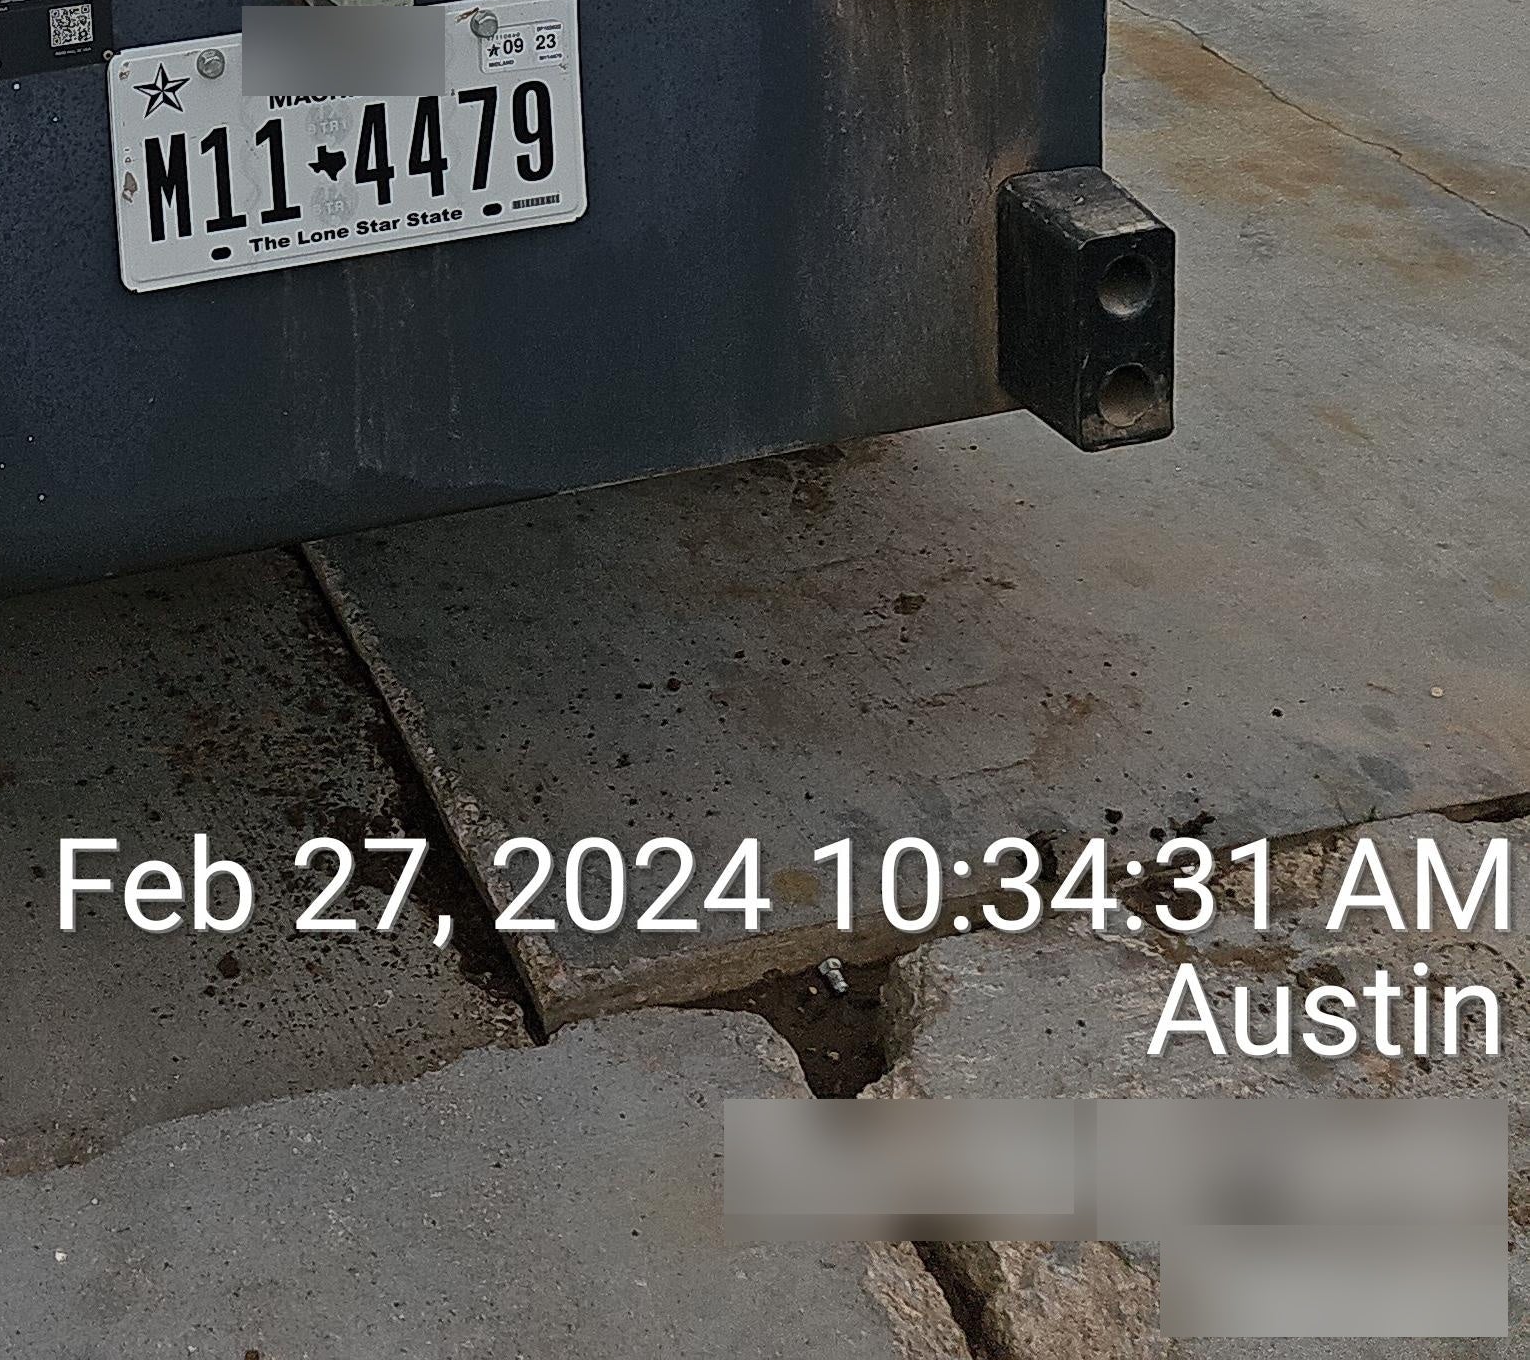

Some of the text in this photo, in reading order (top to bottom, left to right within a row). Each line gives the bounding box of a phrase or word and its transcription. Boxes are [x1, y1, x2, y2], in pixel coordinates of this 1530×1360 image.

[503, 37, 524, 55] 09
[535, 33, 557, 51] 23
[144, 80, 554, 243] M11 4479
[249, 207, 463, 254] The Lone Star State
